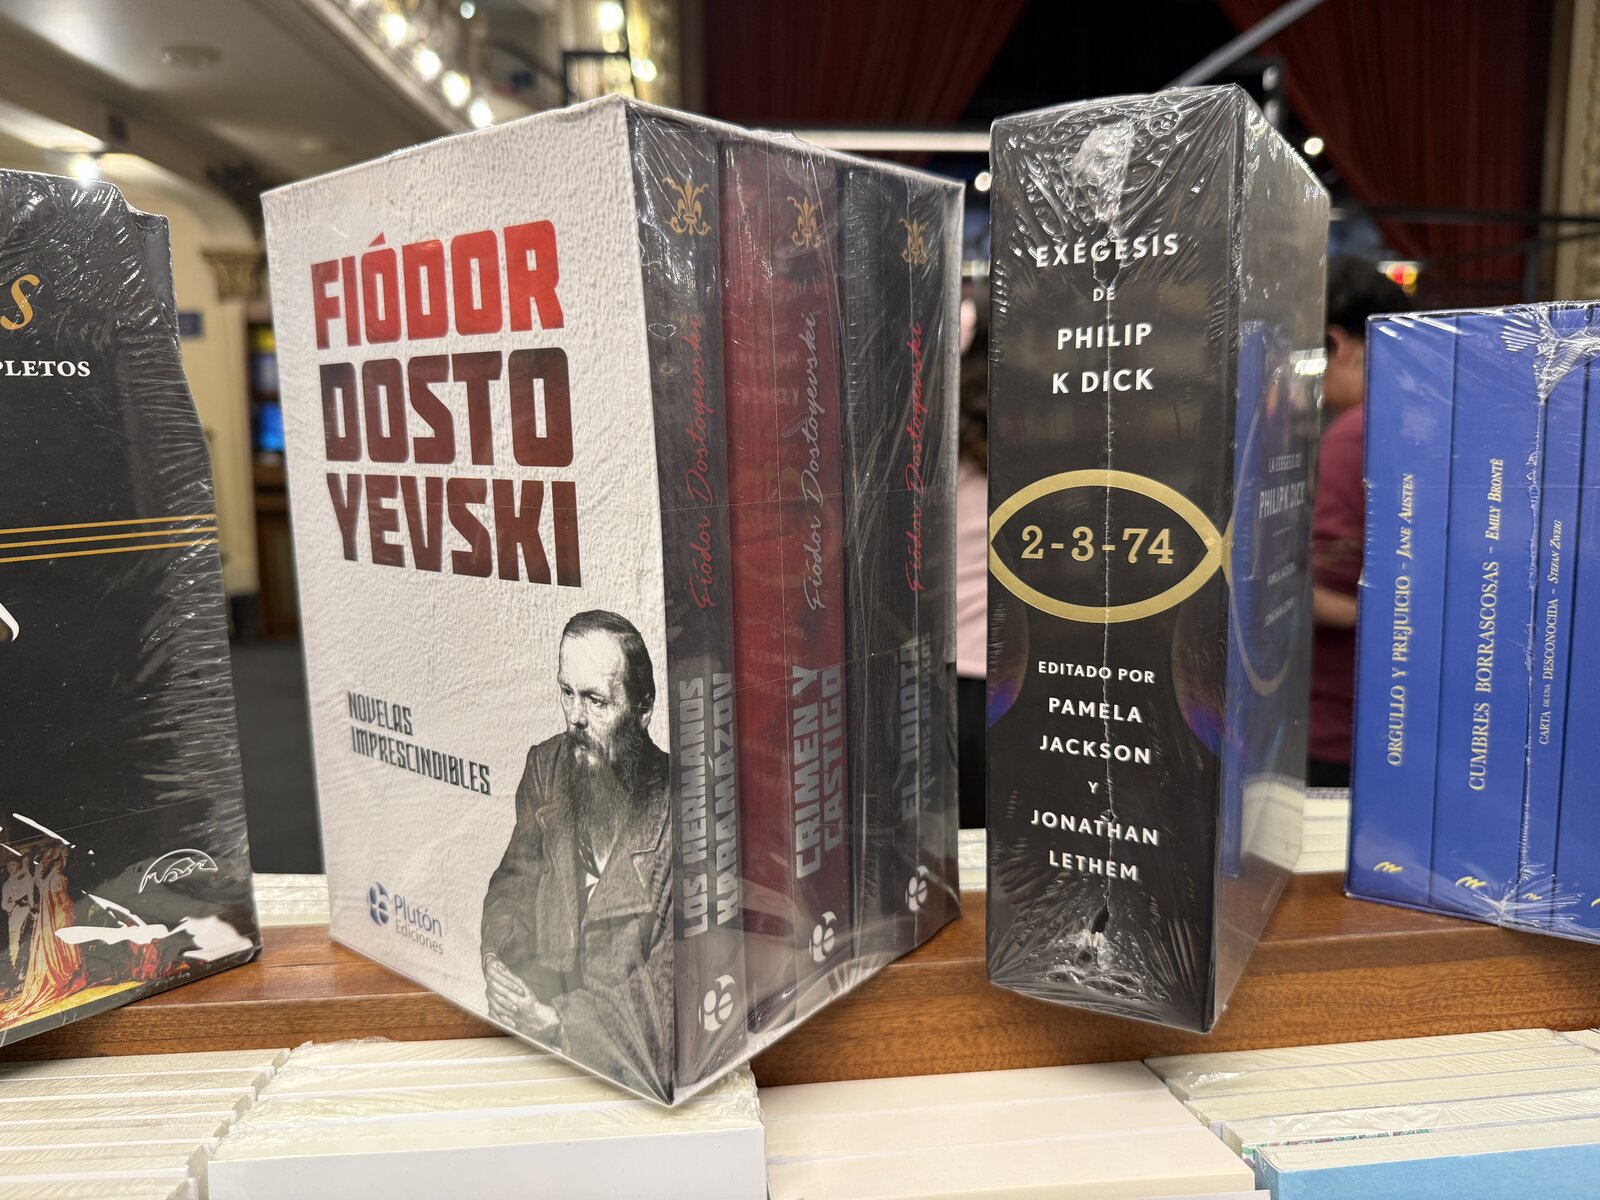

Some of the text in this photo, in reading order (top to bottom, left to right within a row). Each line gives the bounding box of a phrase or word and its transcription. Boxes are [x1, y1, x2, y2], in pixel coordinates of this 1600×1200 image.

[1036, 233, 1179, 267] EXÉGESIS
[311, 220, 564, 350] FIÓDOR
[1093, 288, 1116, 301] DE
[1057, 322, 1152, 350] PHILIP
[1052, 368, 1154, 394] K DICK
[319, 347, 574, 467] DOSTO
[799, 311, 826, 611] Fiódor Dostoyevski
[1487, 458, 1503, 503] BRONTË
[1259, 484, 1284, 519] PHILIP
[1398, 473, 1414, 523] AUSTEN
[326, 473, 582, 587] YEVSKI
[1021, 525, 1174, 564] 2-3-74
[1396, 527, 1412, 560] JANE
[1485, 506, 1500, 541] EMILY
[1550, 520, 1562, 550] ZWEIG
[689, 515, 717, 609] Fiódor
[1547, 551, 1560, 584] STEFAN
[1392, 576, 1412, 662] PREJUICIO
[1475, 561, 1499, 693] BORRASCOSAS
[1543, 598, 1558, 680] DESCONOCIDA
[1038, 661, 1155, 684] EDITADO POR
[1392, 667, 1407, 678] Y
[347, 691, 413, 736] NOVELAS
[900, 637, 919, 820] EL IDIOTA
[1049, 697, 1143, 723] PAMELA
[1387, 685, 1406, 766] ORGULLO
[1539, 711, 1551, 744] CARTA
[351, 724, 492, 796] IMPRESCINDIBLES
[822, 664, 844, 851] CASTIGO
[1040, 735, 1151, 764] JACKSON
[1469, 702, 1490, 790] CUMBRES
[793, 664, 821, 878] CRIMEN Y
[1088, 781, 1098, 794] Y
[679, 677, 708, 938] LOS HERMANOS
[708, 672, 738, 926] KARAMÁZOV
[1031, 809, 1159, 846] JONATHAN
[1049, 850, 1140, 881] LETHEM
[394, 894, 442, 937] Plutón
[395, 918, 444, 955] Ediciones
